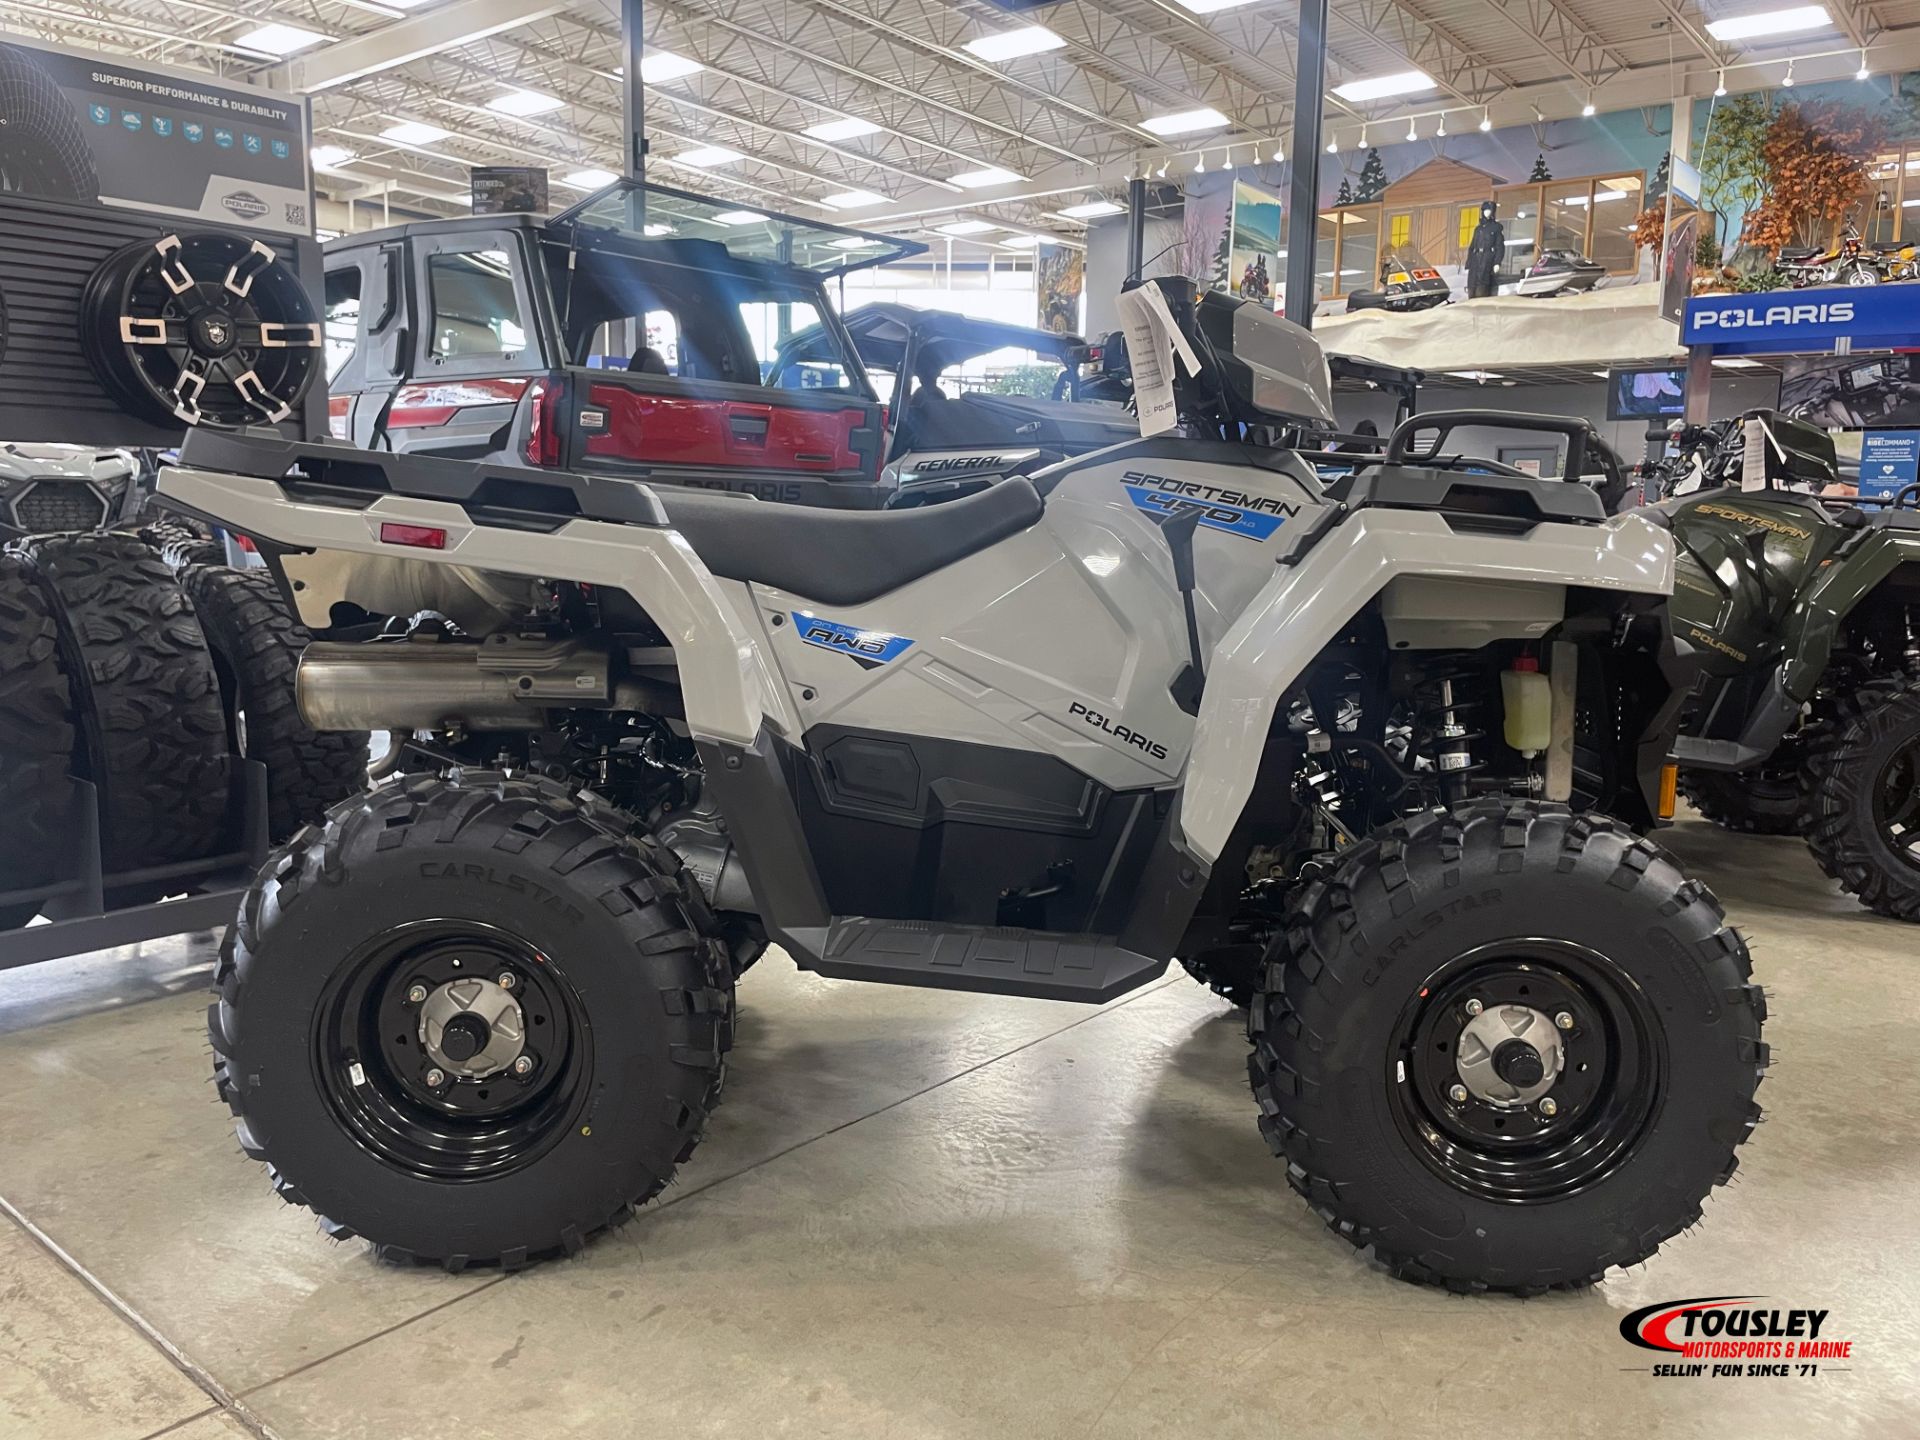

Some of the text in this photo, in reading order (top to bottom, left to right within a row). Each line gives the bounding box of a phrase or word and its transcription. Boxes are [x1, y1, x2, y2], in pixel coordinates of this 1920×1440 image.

[92, 72, 287, 121] SUPERIOR PERFORMANCE & DURABILITY
[225, 199, 266, 212] POLARIS
[1693, 303, 1855, 330] POLARIS
[914, 456, 1005, 472] GENERAL
[1119, 471, 1301, 518] SPORTSMAN
[1694, 504, 1812, 540] SPORTSMAN
[805, 628, 887, 654] AWD
[1689, 628, 1748, 663] POLARIS
[1068, 701, 1168, 760] POLARIS
